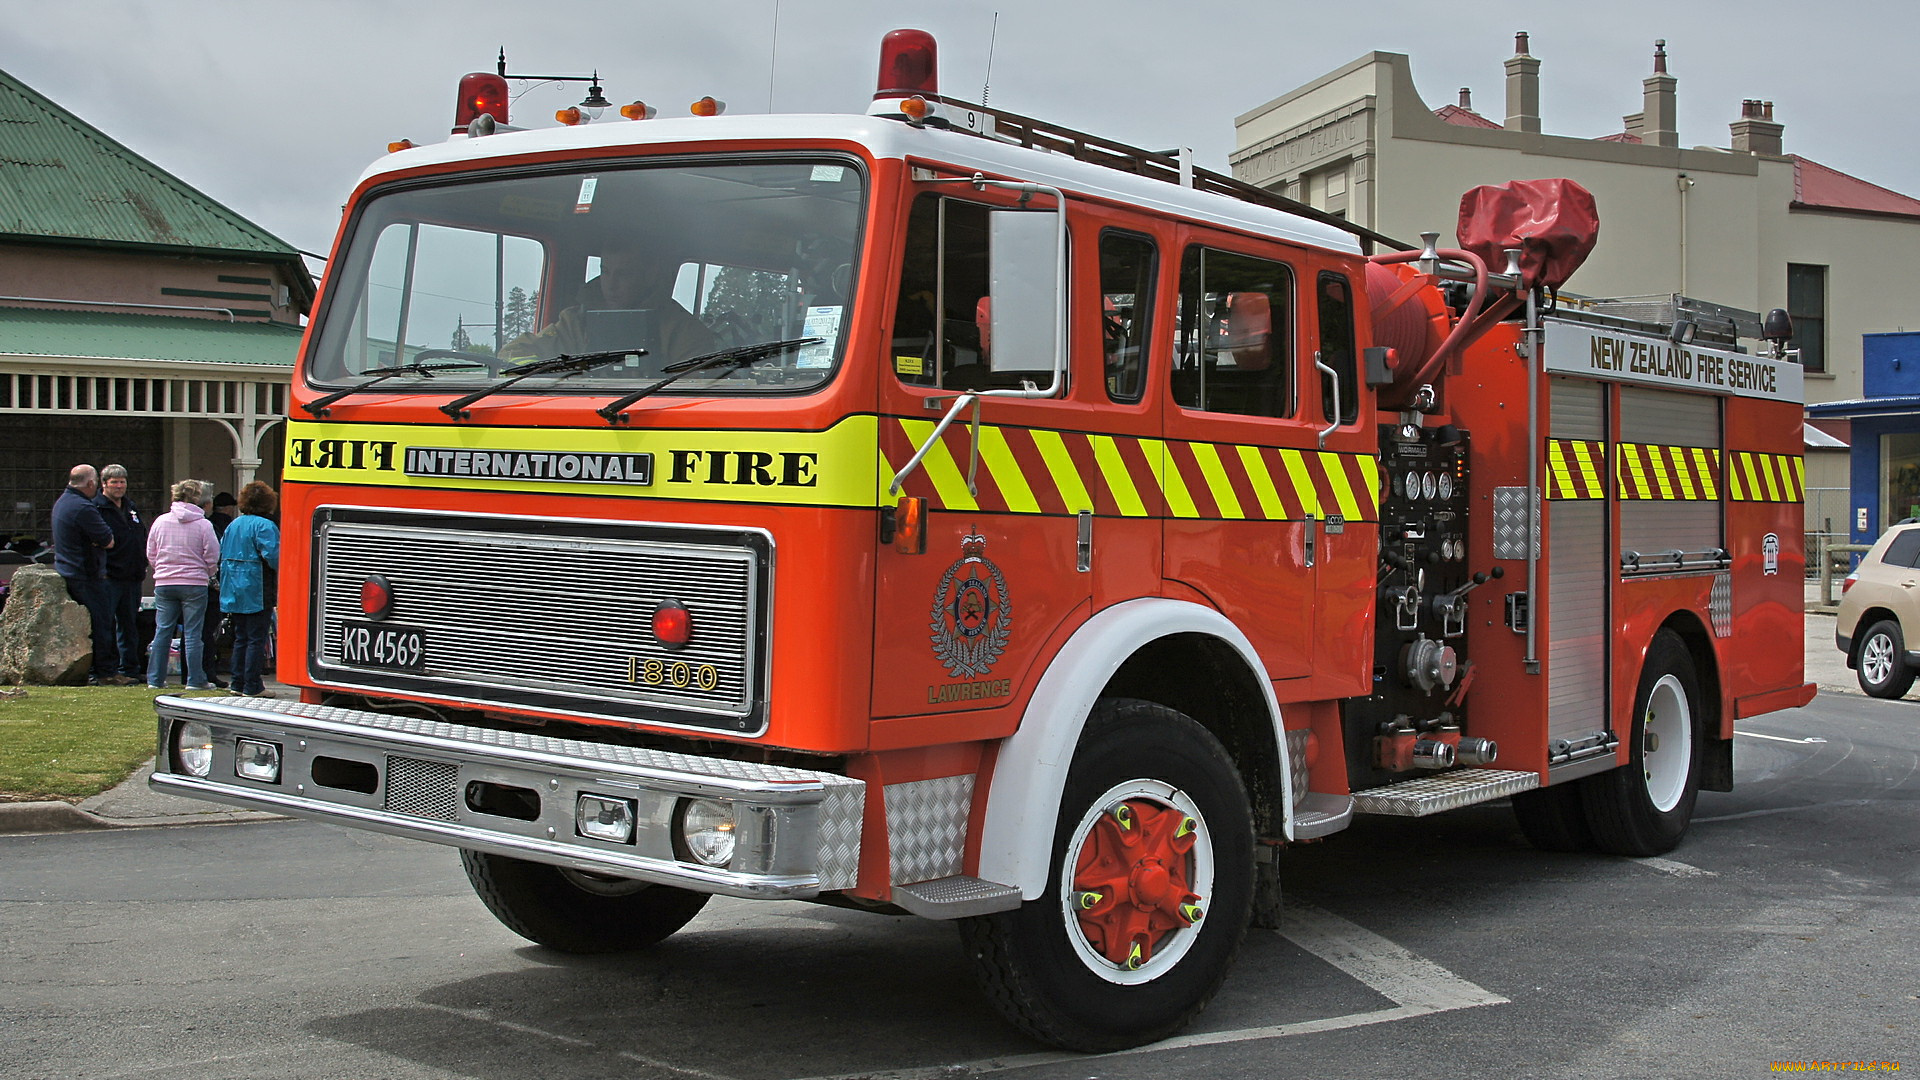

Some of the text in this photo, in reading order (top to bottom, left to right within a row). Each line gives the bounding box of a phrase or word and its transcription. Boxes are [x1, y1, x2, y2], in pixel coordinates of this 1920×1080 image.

[968, 112, 975, 128] 9
[1240, 120, 1356, 182] BANK OF NEW ZEALAND
[1591, 335, 1776, 393] NEW ZEALAND FIRE SERVICE
[407, 449, 644, 481] INTERNATIONAL
[1398, 446, 1428, 454] WORMALD
[667, 450, 818, 487] FIRE
[344, 627, 420, 666] KR 4569
[628, 657, 717, 691] 1800
[928, 679, 1011, 704] LAWRENCE
